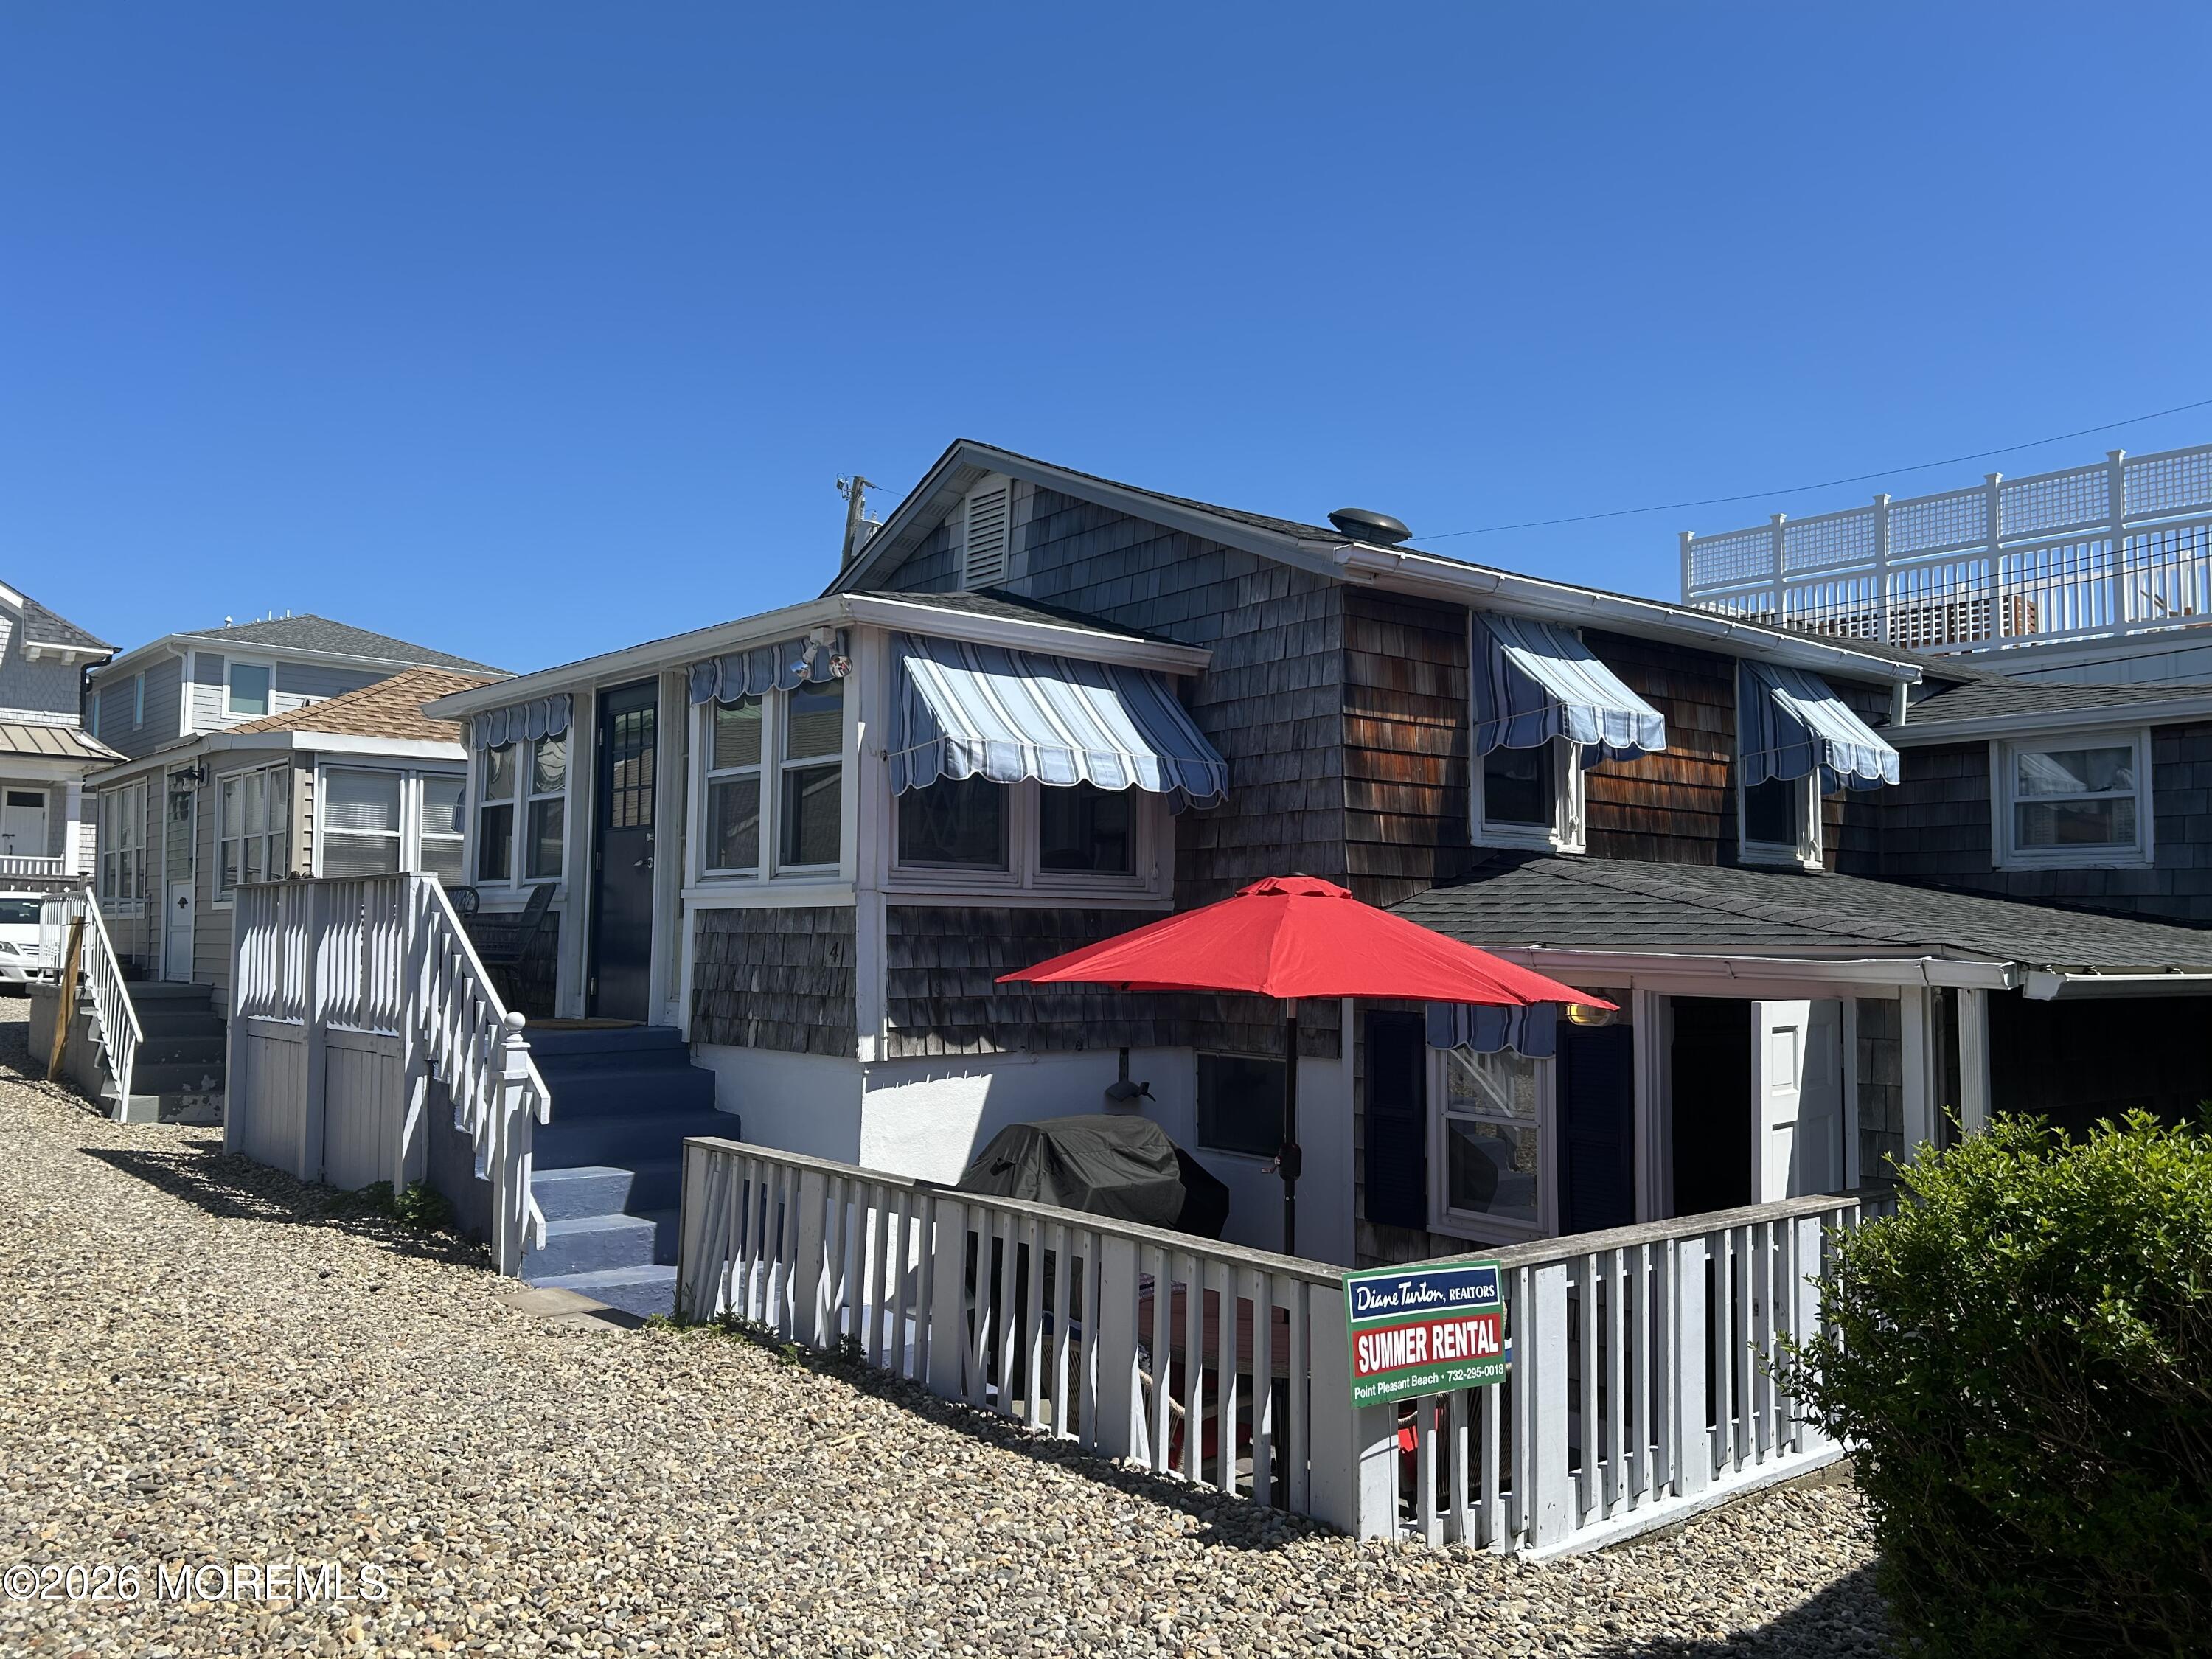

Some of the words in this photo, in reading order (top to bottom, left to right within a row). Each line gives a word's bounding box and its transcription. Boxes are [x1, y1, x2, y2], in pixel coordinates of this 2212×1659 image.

[830, 942, 838, 964] 4
[1357, 1286, 1399, 1311] Diane
[1398, 1281, 1447, 1306] Turton,
[1449, 1284, 1495, 1301] REALTORS
[1358, 1326, 1428, 1374] SUMMER
[1432, 1319, 1499, 1360] RENTAL
[1354, 1384, 1376, 1399] Point
[1377, 1377, 1410, 1394] Pleasant
[1411, 1373, 1439, 1388] Beach
[1447, 1363, 1504, 1382] 732-295-0018
